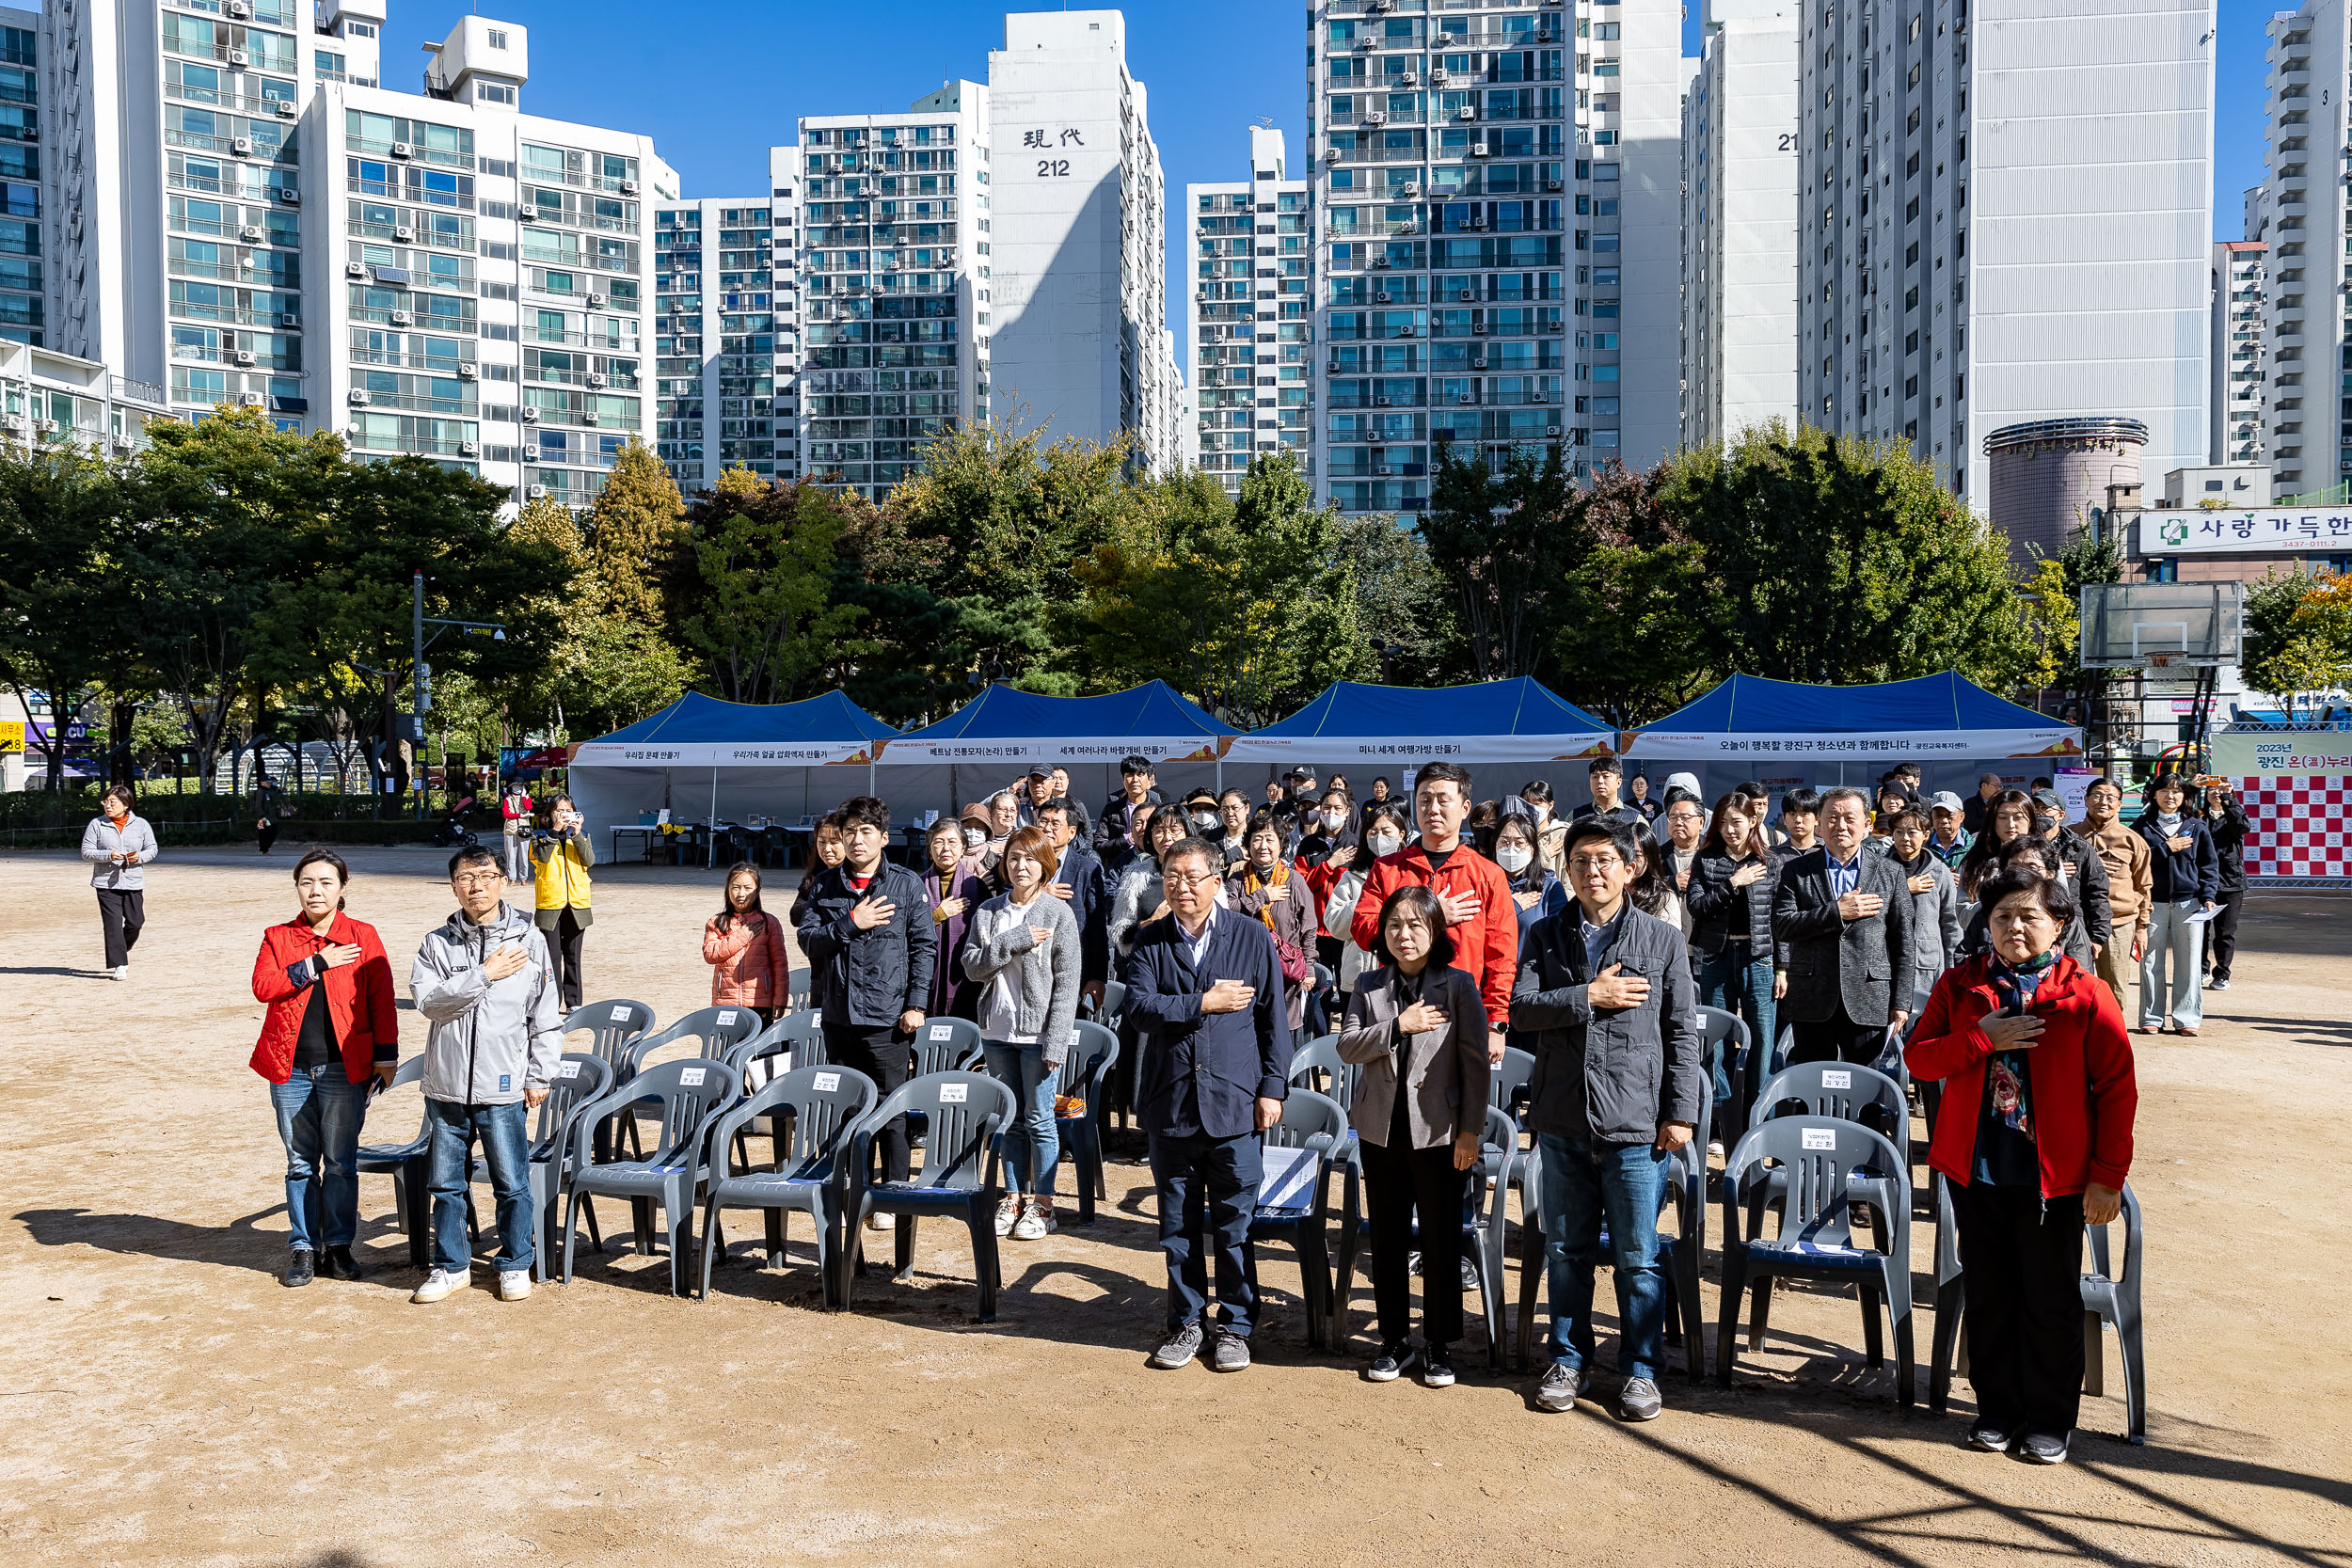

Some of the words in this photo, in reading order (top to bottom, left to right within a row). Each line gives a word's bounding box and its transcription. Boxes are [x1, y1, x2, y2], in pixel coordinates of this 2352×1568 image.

[2322, 89, 2328, 105] 3
[1038, 159, 1070, 177] 212
[68, 726, 86, 738] CU
[1060, 746, 1075, 755] 세계
[1077, 746, 1107, 755] 여러나라
[1110, 746, 1141, 755] 바람개비
[1143, 746, 1167, 755] 만들기
[1359, 745, 1375, 754] 미니
[1378, 745, 1395, 754] 세계
[1398, 745, 1432, 754] 여행가방
[1435, 744, 1461, 754] 만들기
[1720, 740, 1748, 751] 오늘이
[1752, 740, 1781, 752] 행복할
[1784, 740, 1813, 752] 광진구
[1817, 740, 1856, 751] 청소년과
[1859, 739, 1910, 751] 함께합니다
[2256, 743, 2292, 752] 2023년
[660, 752, 680, 760] 만들기
[733, 751, 759, 759] 우리가족
[762, 751, 775, 759] 얼굴
[777, 751, 804, 759] 압화액자
[806, 750, 828, 759] 만들기
[930, 747, 951, 756] 베트남
[953, 747, 1003, 756] 전통모자(논라)
[1005, 746, 1027, 756] 만들기
[2258, 756, 2284, 768] 광진
